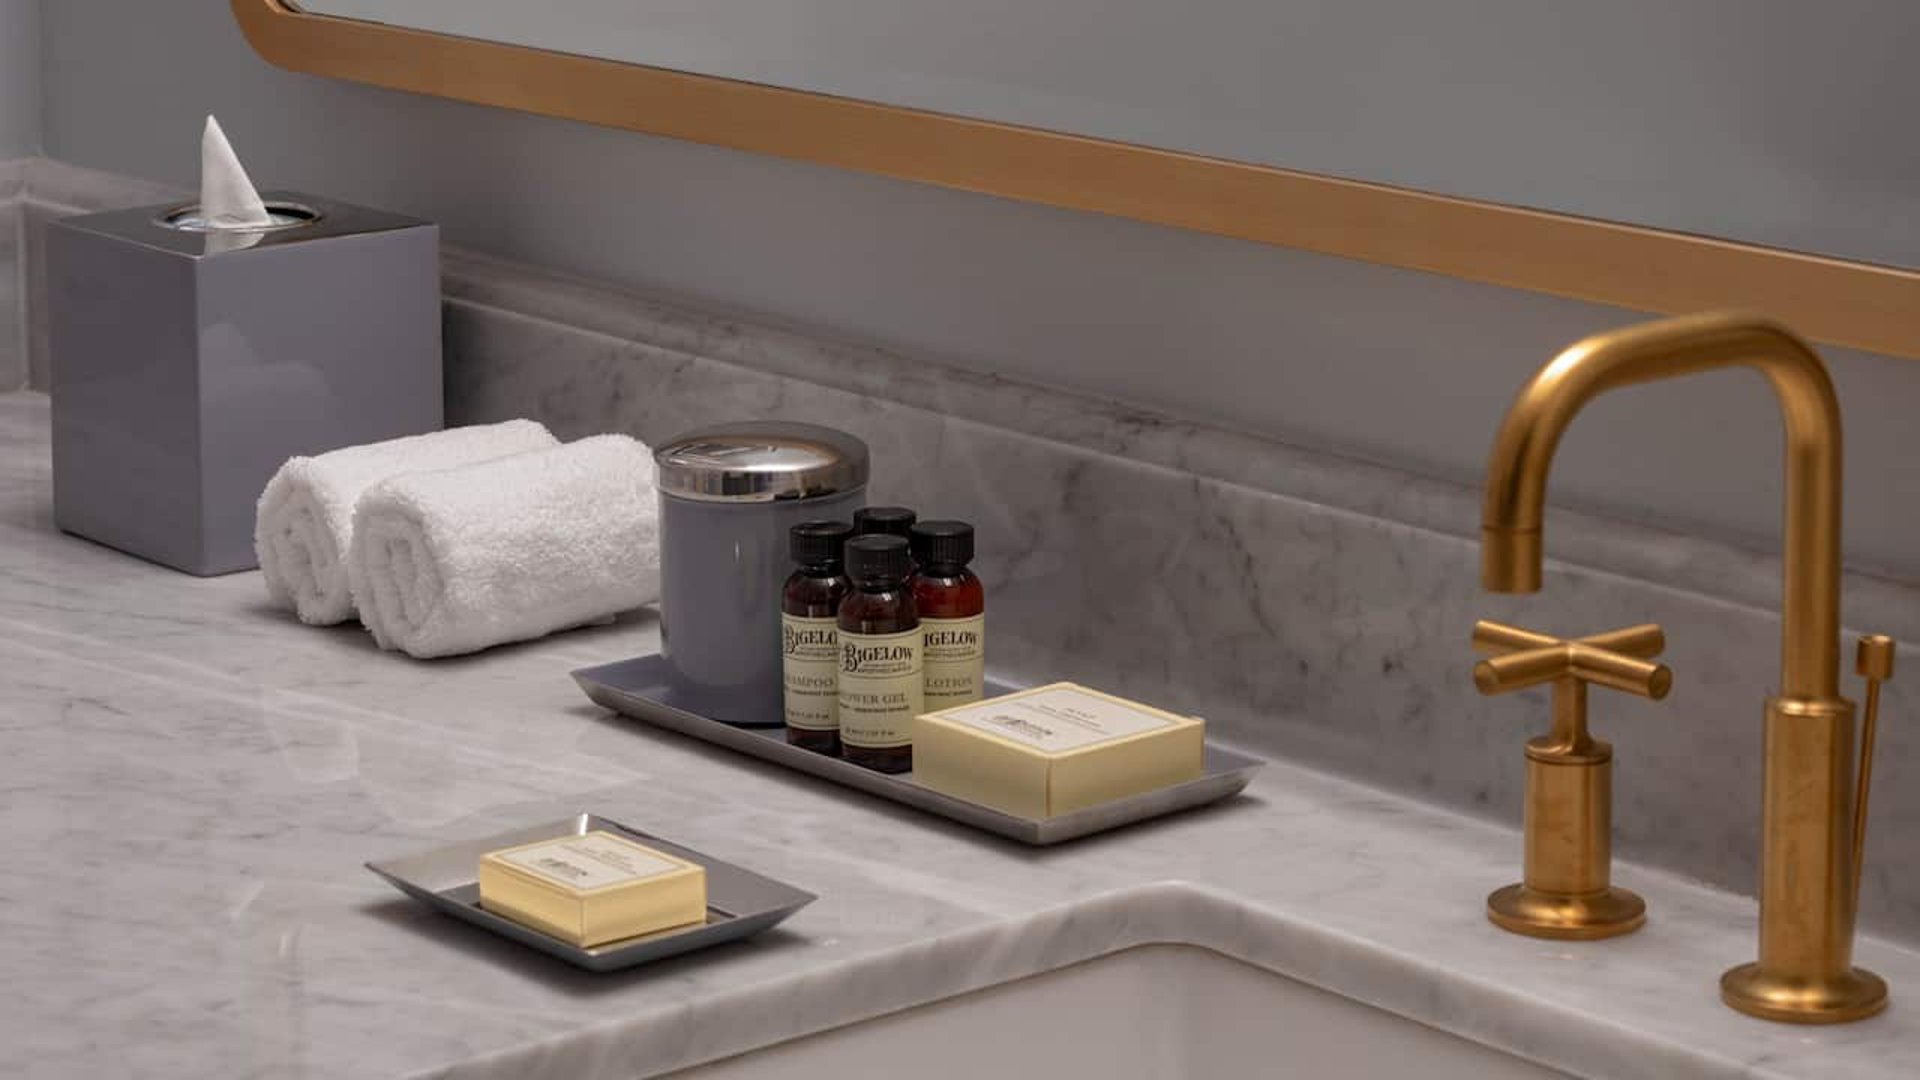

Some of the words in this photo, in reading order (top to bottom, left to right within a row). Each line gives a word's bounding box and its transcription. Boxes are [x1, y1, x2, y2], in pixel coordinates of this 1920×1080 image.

[784, 624, 838, 655] BIGELO
[923, 630, 977, 649] IGELOW
[841, 642, 913, 673] BIGELOW
[925, 677, 972, 688] LOTION
